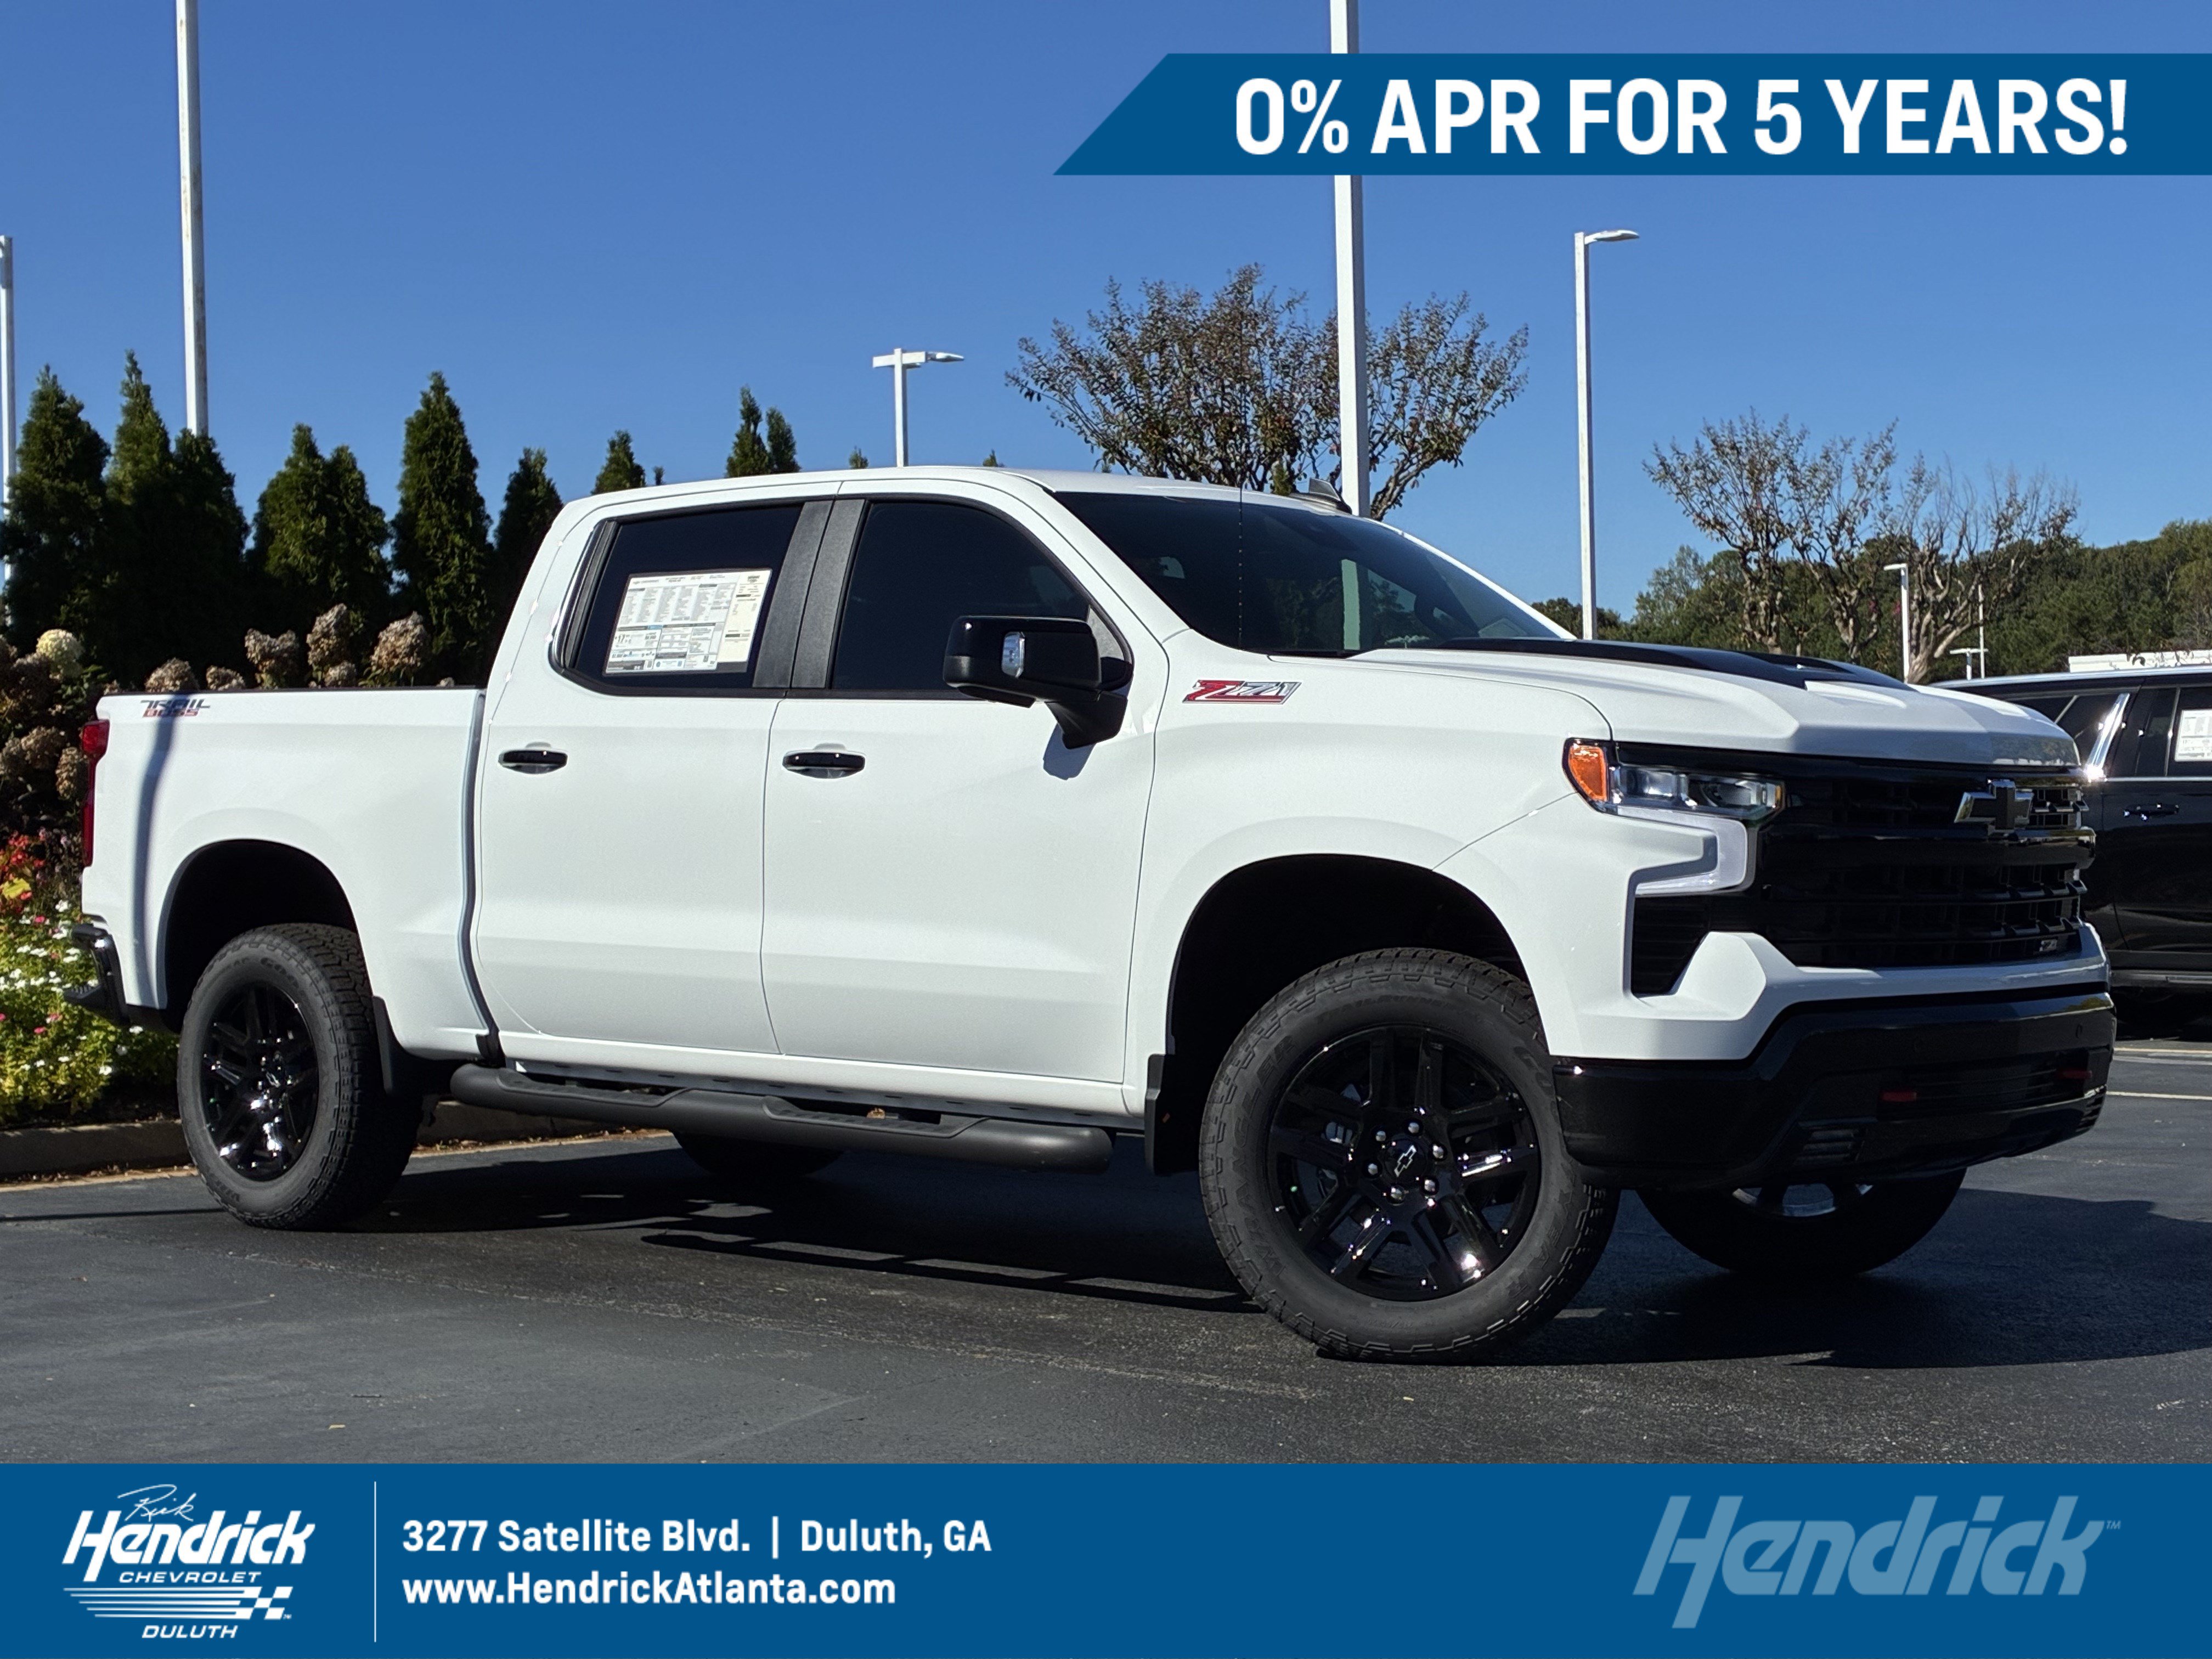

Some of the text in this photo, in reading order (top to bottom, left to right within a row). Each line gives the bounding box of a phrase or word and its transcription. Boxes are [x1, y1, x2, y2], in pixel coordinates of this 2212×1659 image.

[140, 698, 211, 709] TRAIL
[1182, 679, 1302, 704] Z71
[1231, 1035, 1297, 1278] WRANGLER
